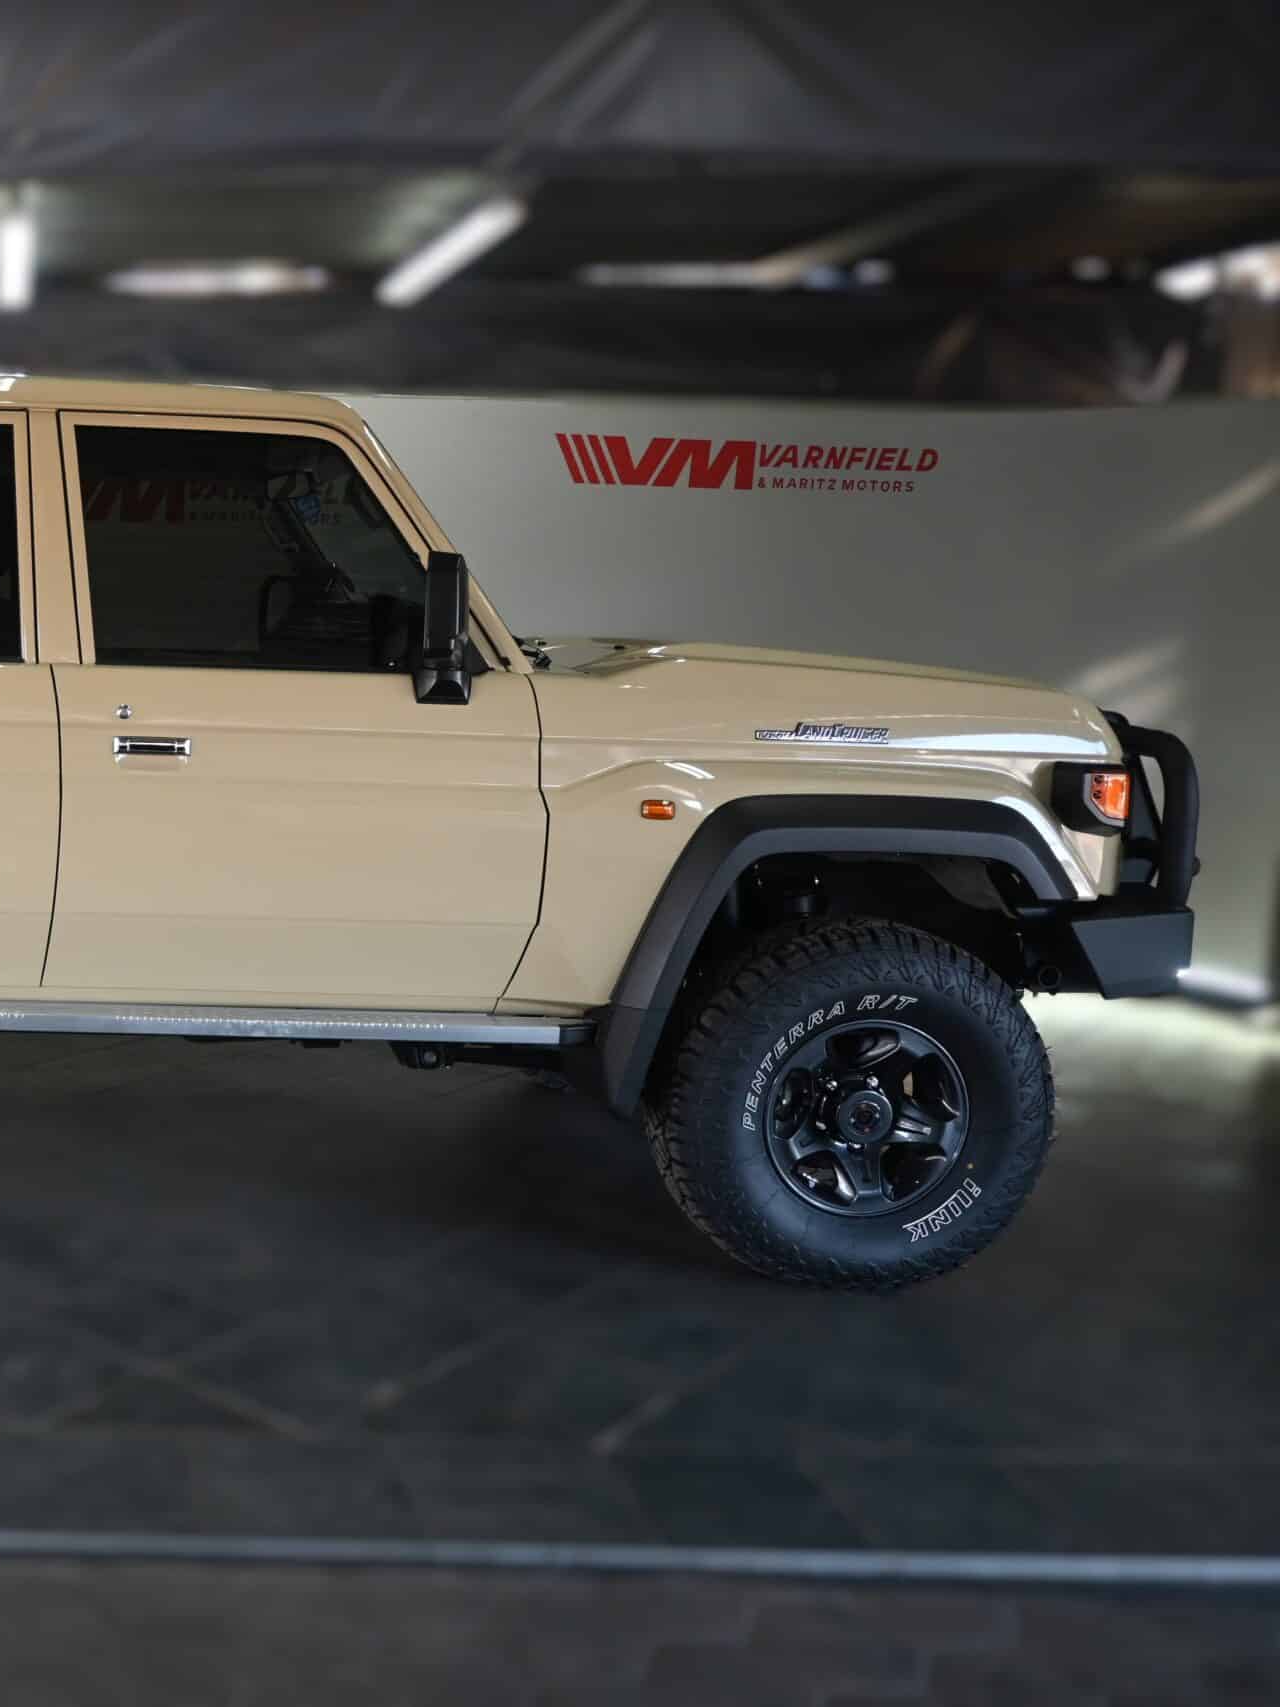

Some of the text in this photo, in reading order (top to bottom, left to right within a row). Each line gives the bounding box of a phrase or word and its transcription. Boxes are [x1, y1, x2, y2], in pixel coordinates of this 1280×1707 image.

[759, 444, 939, 472] VARNFIELD
[757, 477, 915, 493] & MARITZ MOTORS
[742, 994, 918, 1131] PENTERRA R/T
